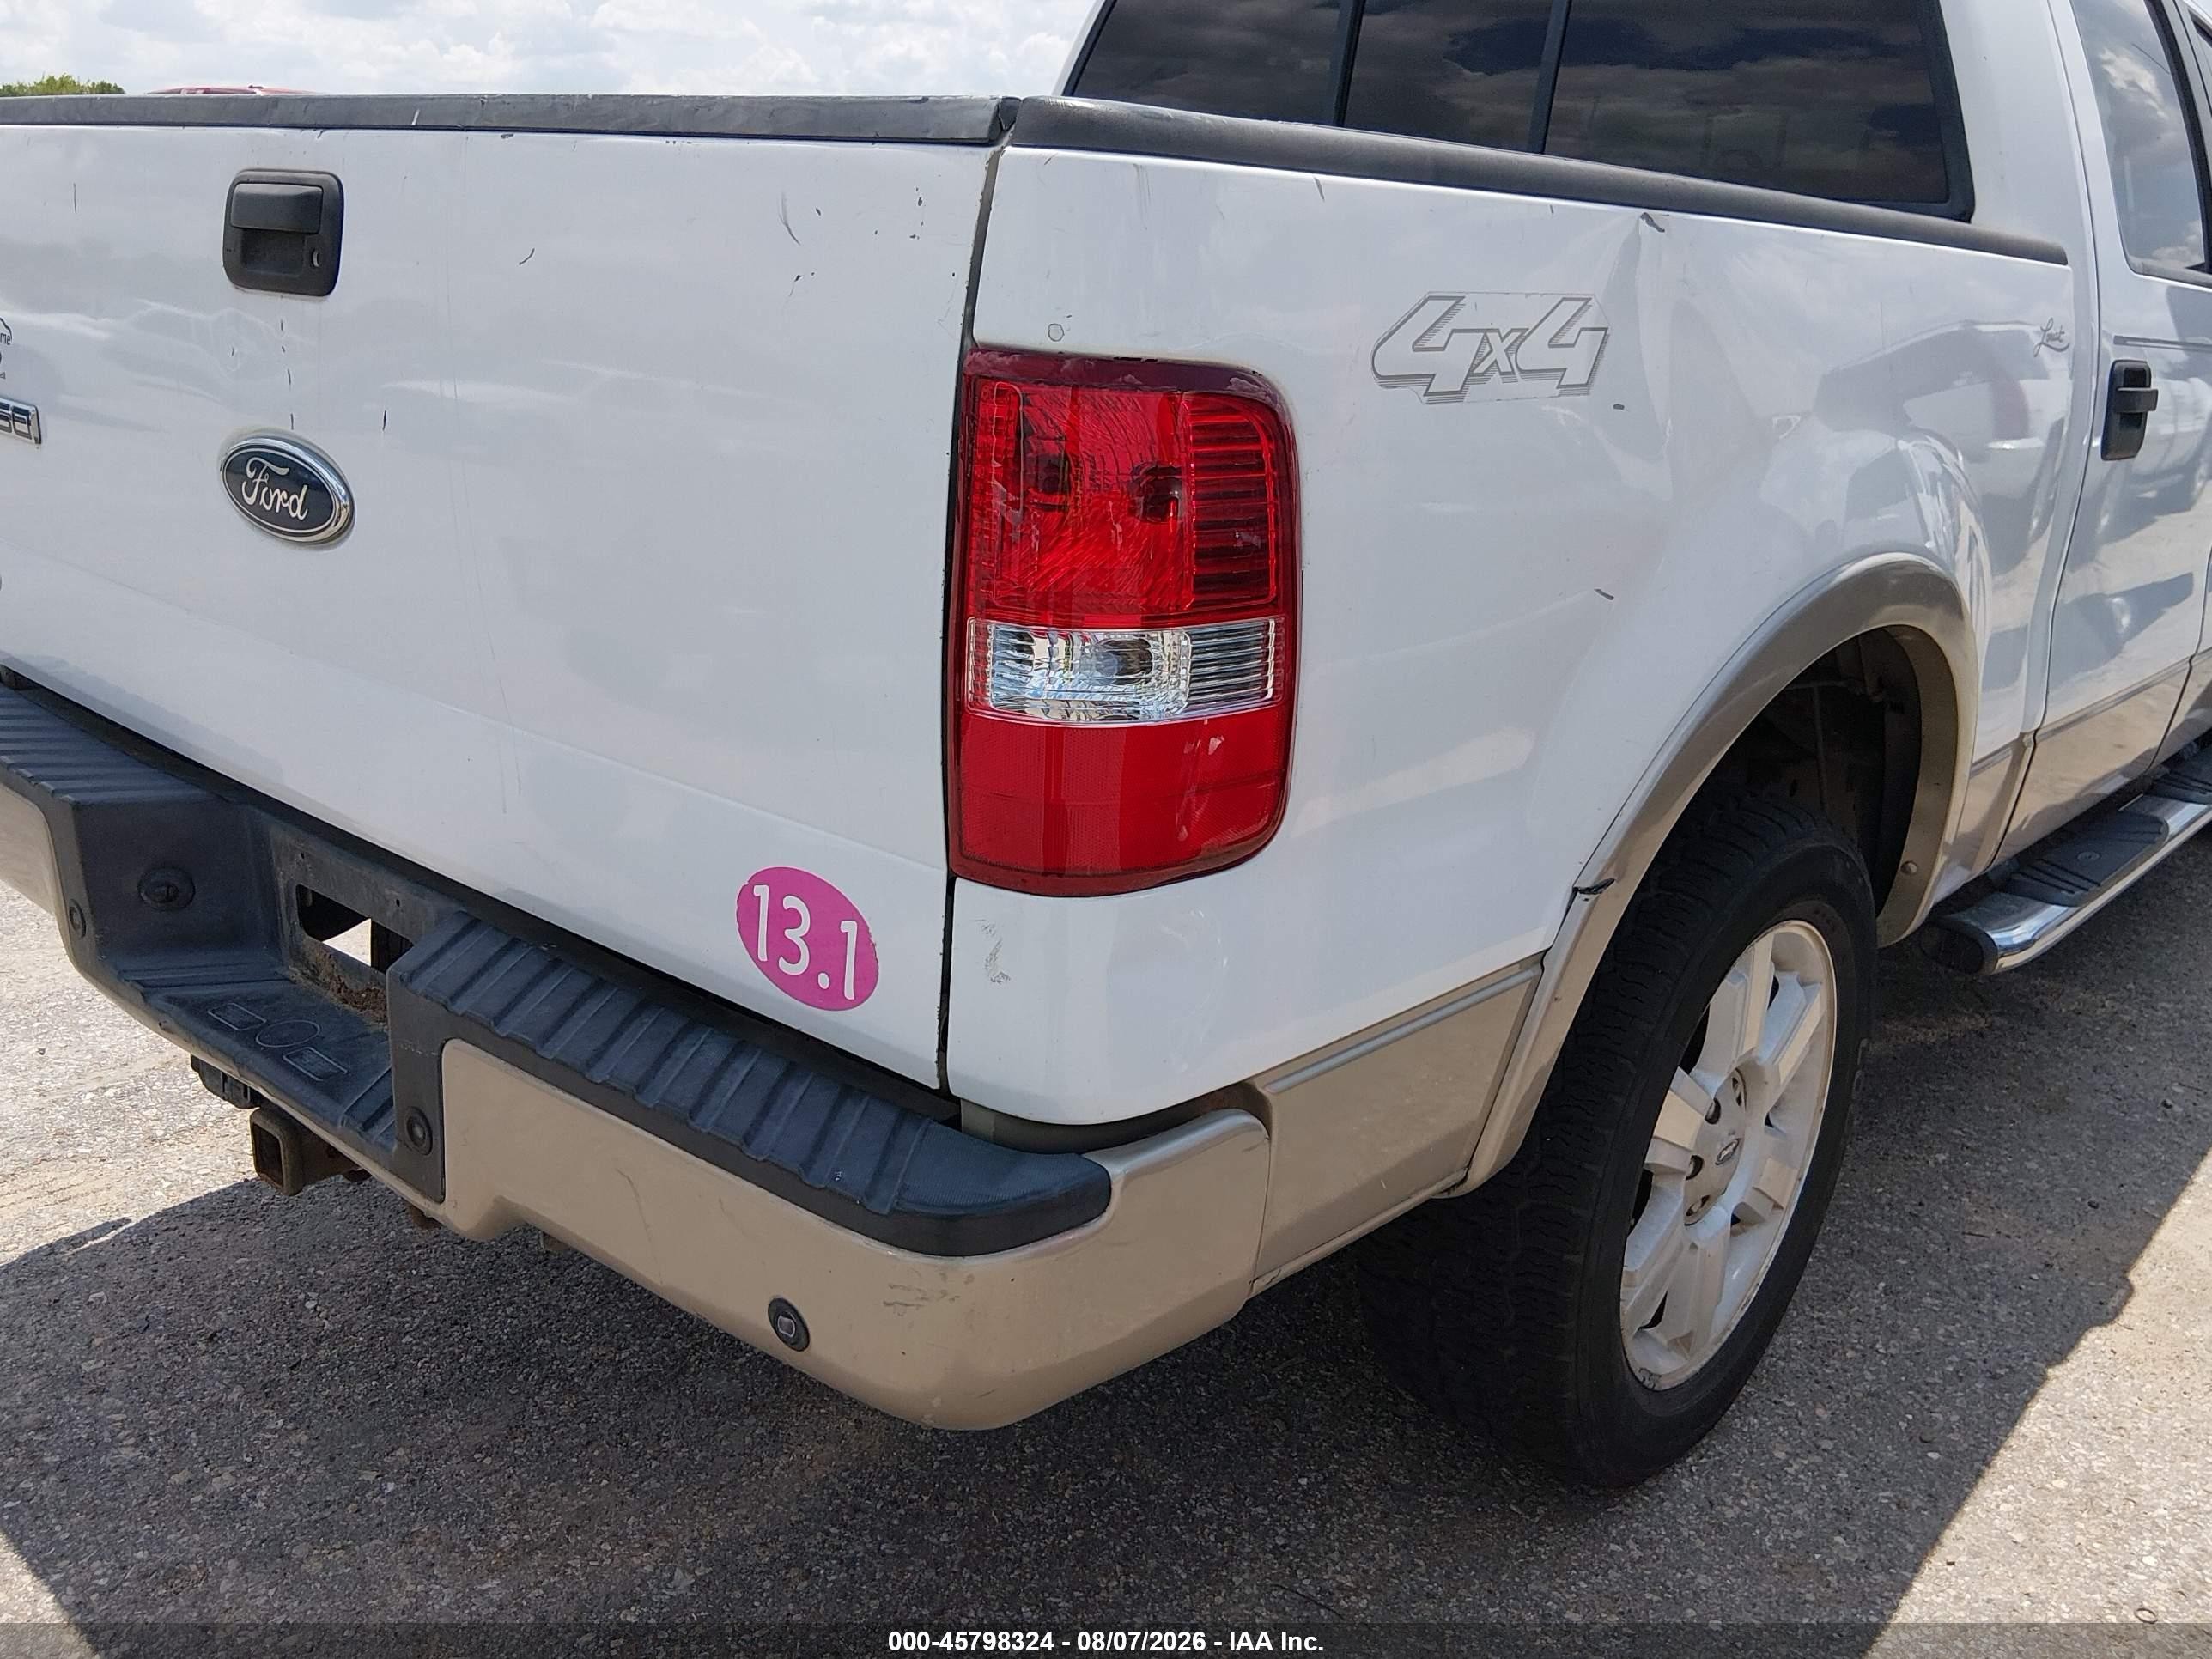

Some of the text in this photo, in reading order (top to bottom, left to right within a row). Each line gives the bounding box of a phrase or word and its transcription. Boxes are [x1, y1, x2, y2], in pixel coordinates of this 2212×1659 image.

[1371, 295, 1610, 404] 4x4
[241, 456, 308, 520] Ford
[753, 884, 858, 1000] 13.1
